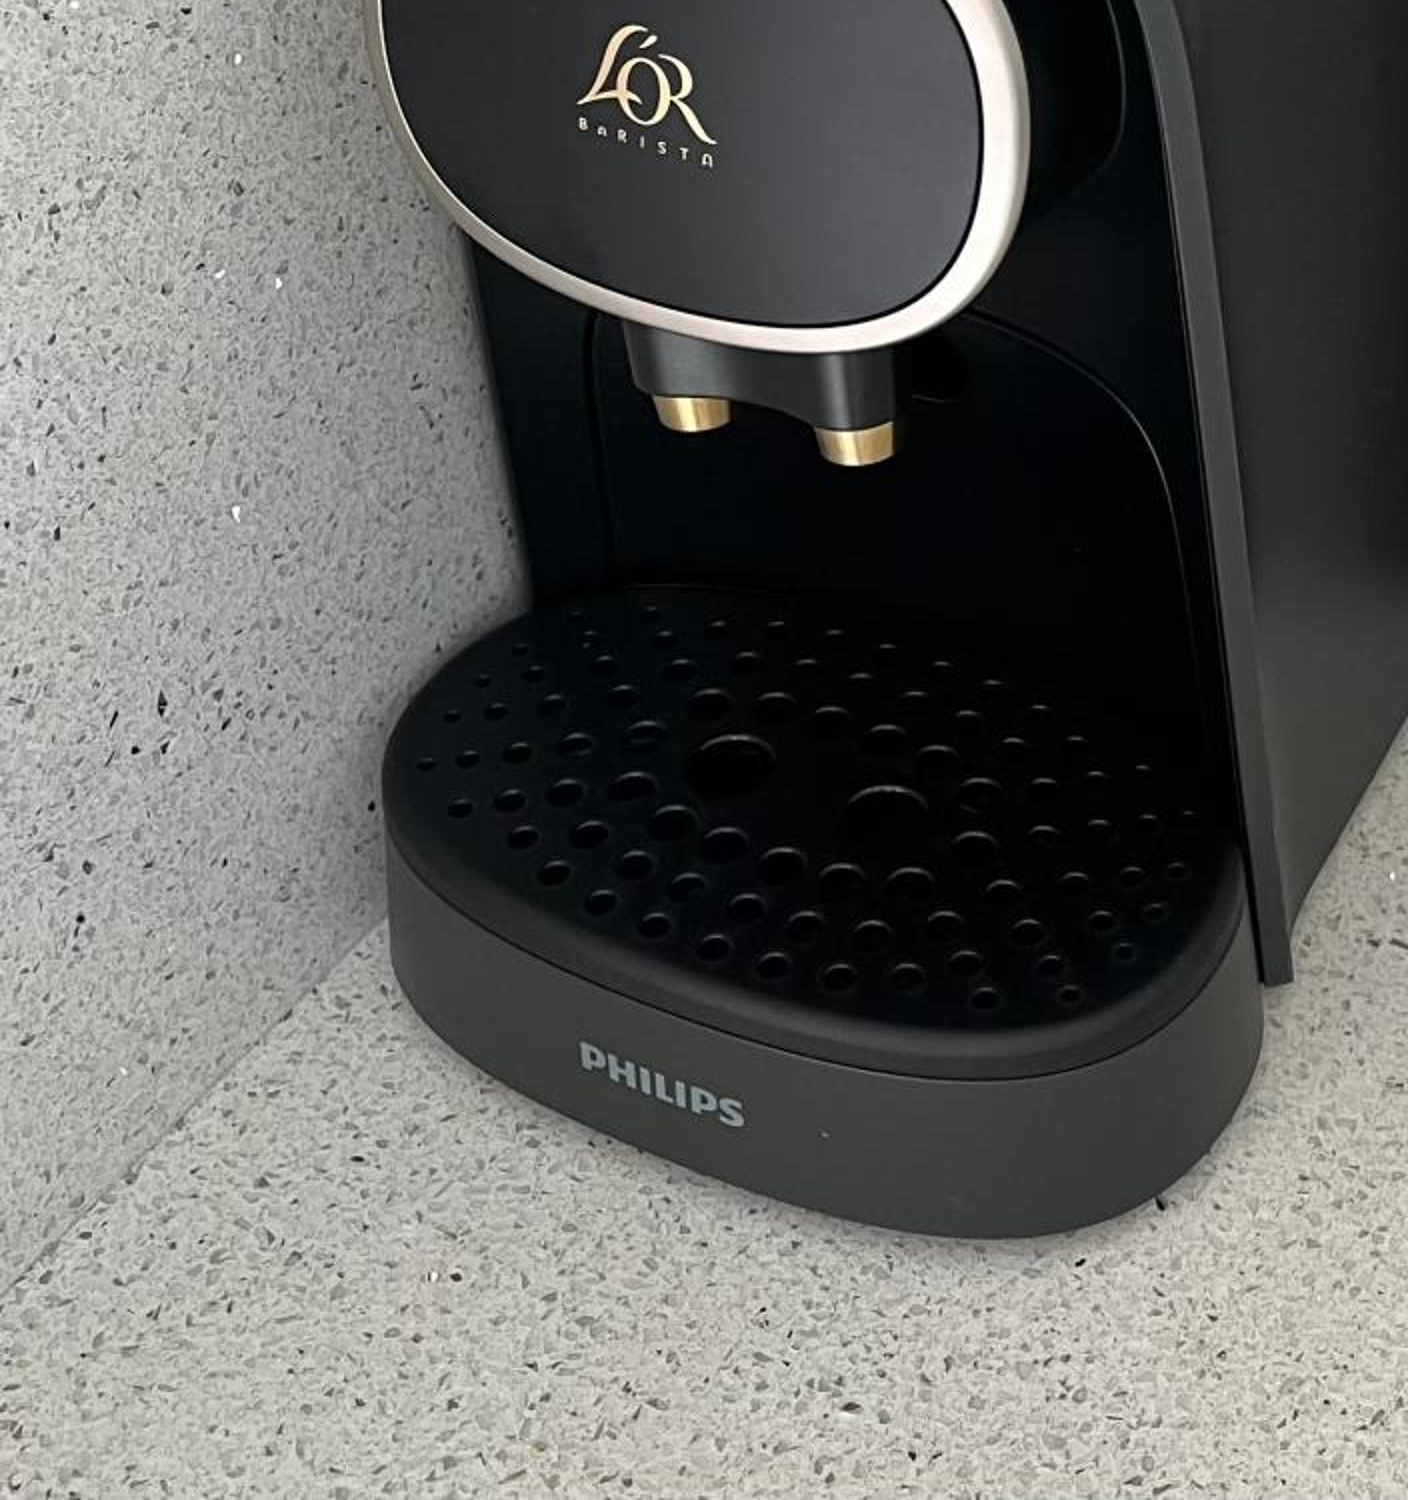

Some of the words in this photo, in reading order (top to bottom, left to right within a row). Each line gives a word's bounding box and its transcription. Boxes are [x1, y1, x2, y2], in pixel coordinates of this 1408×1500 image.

[575, 24, 718, 145] L'OR
[578, 116, 714, 168] BARISTA
[578, 1040, 745, 1128] PHILIPS
